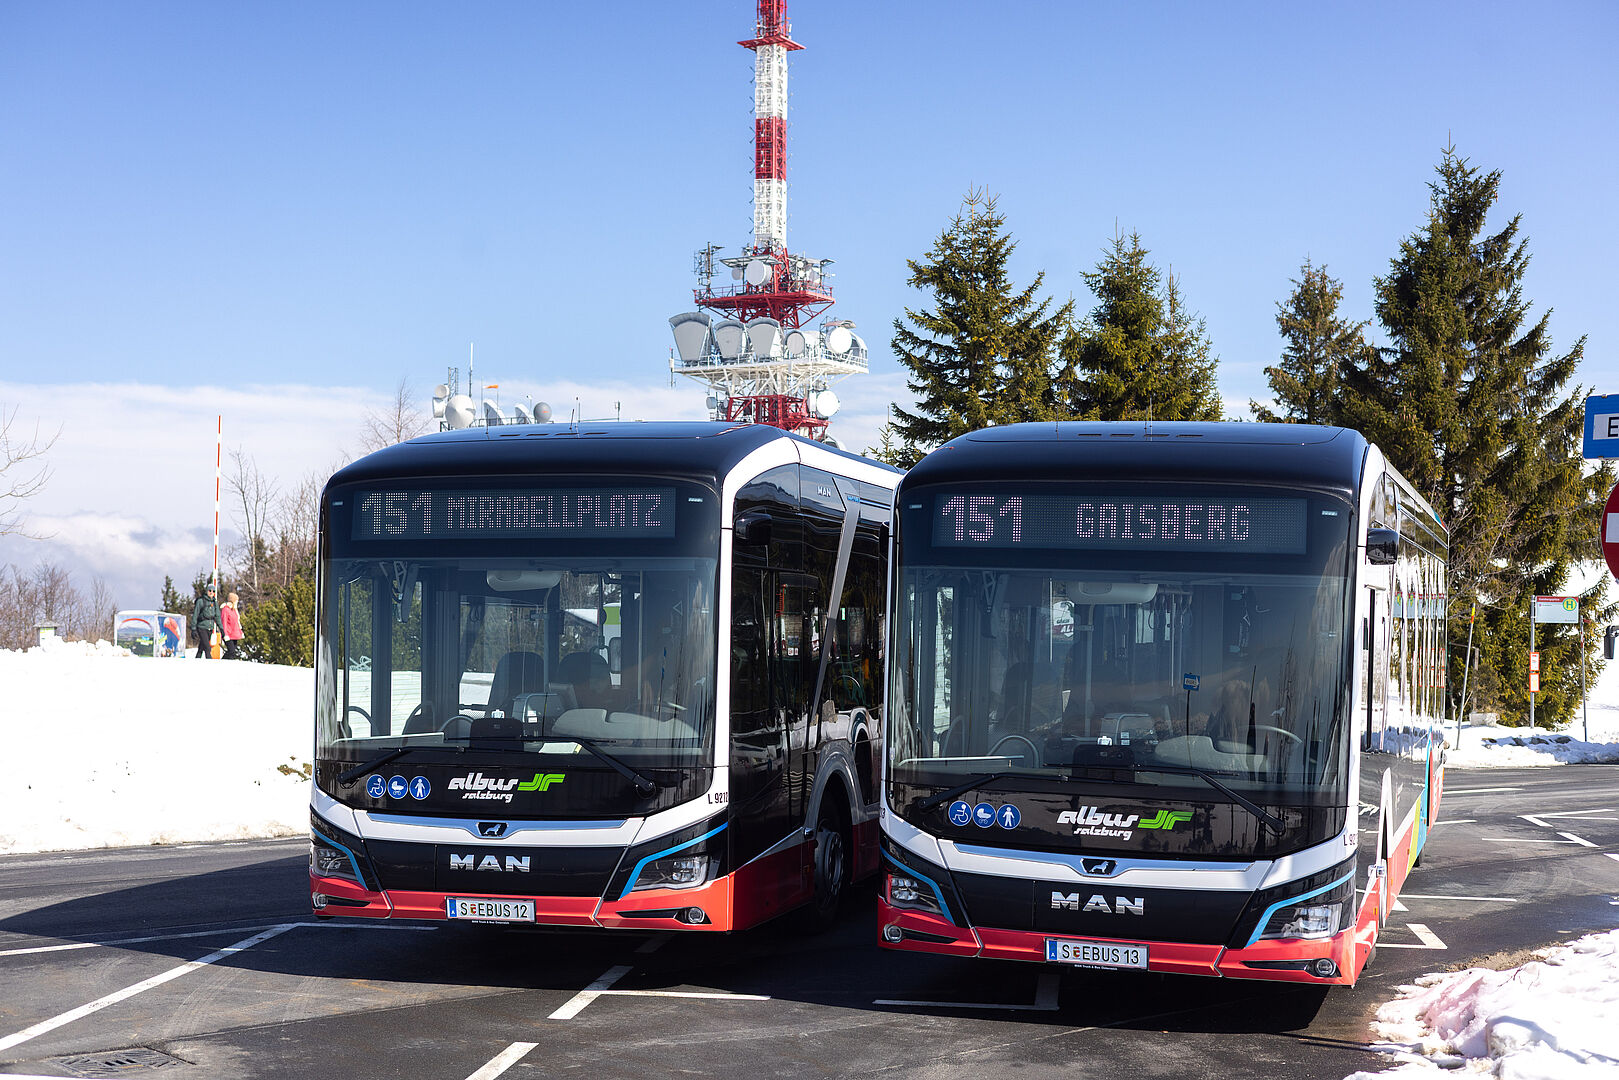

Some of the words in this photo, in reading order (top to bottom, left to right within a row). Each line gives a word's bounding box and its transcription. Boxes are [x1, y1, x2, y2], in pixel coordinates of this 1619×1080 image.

[361, 492, 432, 535] 151
[447, 493, 661, 529] MIRABELLPLATZ
[942, 495, 1023, 542] 151
[1076, 503, 1250, 541] GAISBERG
[447, 772, 519, 791] albus
[462, 790, 514, 804] salzburg
[1056, 805, 1139, 828] albus
[1074, 825, 1133, 841] salzburg
[450, 853, 531, 873] MAN
[460, 902, 468, 916] S
[478, 902, 511, 917] EBUS
[513, 904, 528, 918] 12
[1051, 891, 1144, 916] MAN
[1062, 944, 1070, 959] S
[1083, 946, 1120, 963] EBUS
[1123, 949, 1139, 964] 13
